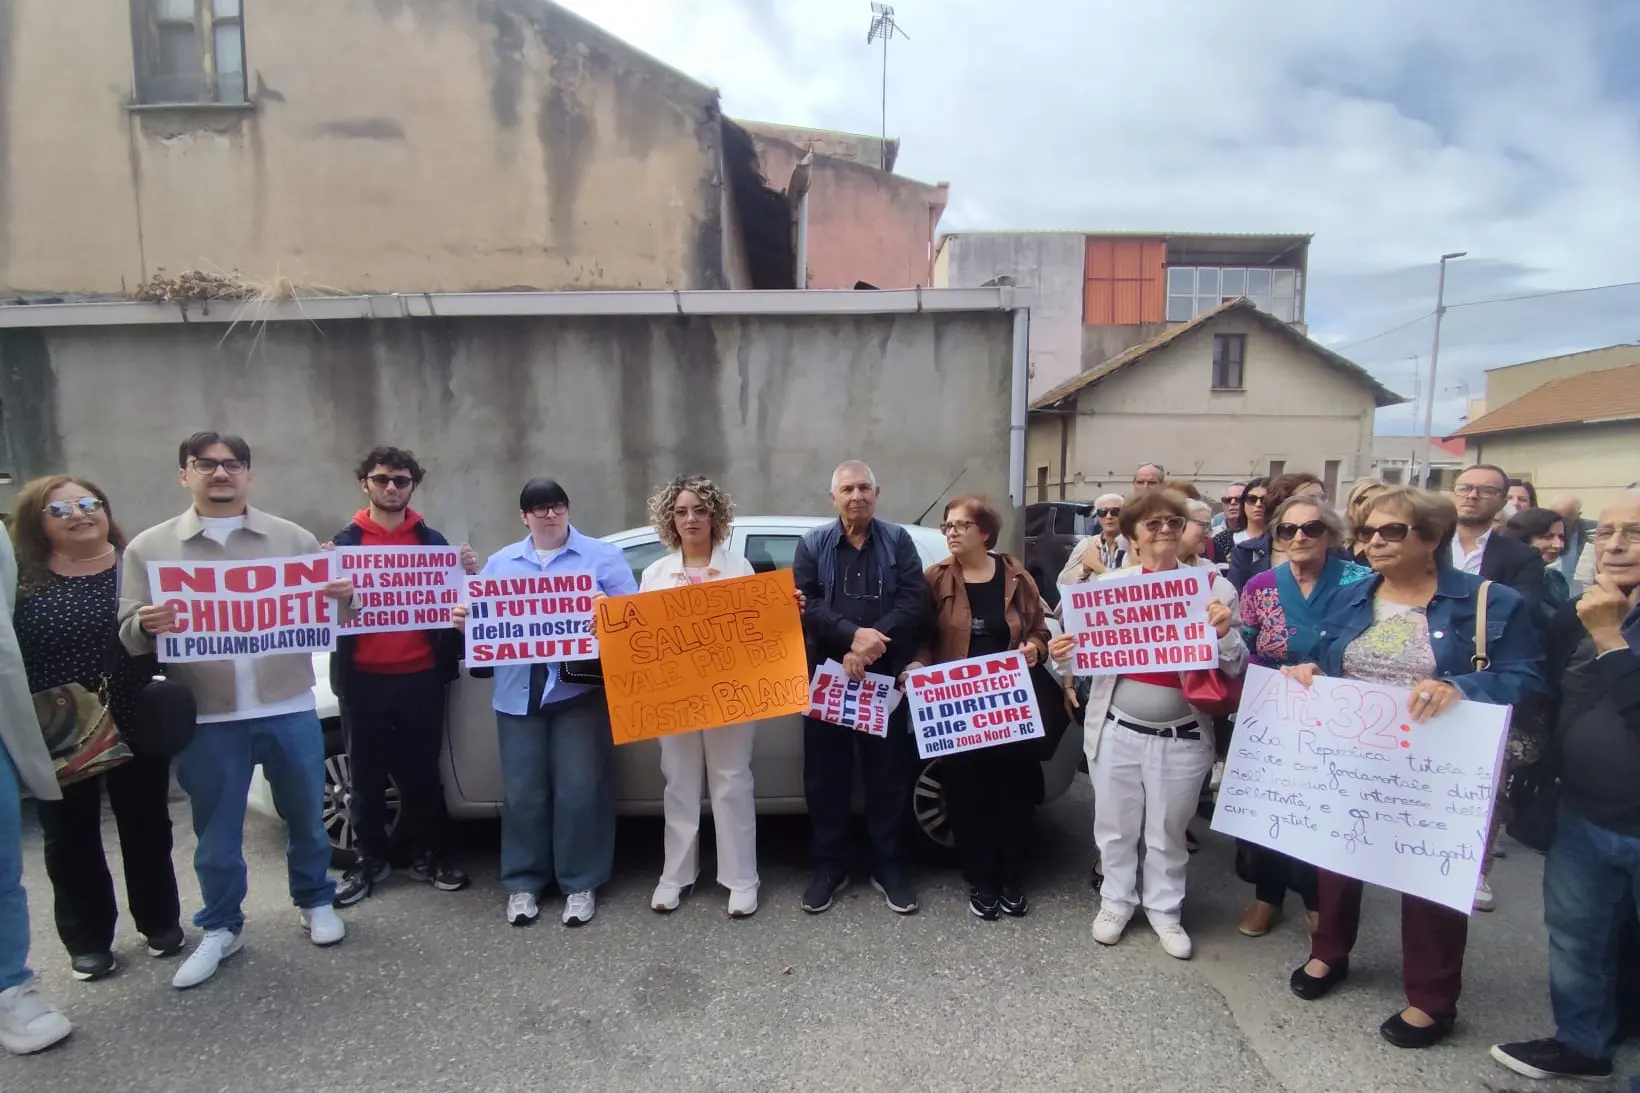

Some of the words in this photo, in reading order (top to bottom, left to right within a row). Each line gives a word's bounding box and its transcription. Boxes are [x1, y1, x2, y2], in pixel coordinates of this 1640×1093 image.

[342, 553, 457, 569] DIFENDIAMO
[159, 558, 329, 593] NON
[352, 573, 375, 588] LA
[379, 571, 449, 588] SANITA'
[468, 574, 592, 598] SALVIAMO
[358, 590, 437, 607] UBBLICA
[441, 588, 458, 604] di
[600, 601, 648, 633] LA
[661, 578, 791, 620] NOSTRA
[1072, 577, 1198, 609] DIFENDIAMO
[163, 590, 331, 633] CHIUDETE
[414, 607, 455, 624] NOR
[472, 602, 488, 619] il
[496, 596, 592, 617] FUTURO
[1085, 610, 1108, 628] LA
[1113, 601, 1190, 625] SANITA'
[165, 637, 181, 657] IL
[184, 627, 331, 656] POLIAMBULATORIO
[472, 622, 524, 640] della
[529, 619, 591, 636] nostra
[630, 610, 763, 664] SALUTE
[1078, 624, 1178, 648] PUBBLICA
[1184, 622, 1205, 640] di
[473, 637, 593, 662] SALUTE
[1077, 648, 1149, 669] REGGIO
[1155, 644, 1212, 665] NORD
[609, 661, 685, 697] VALE
[911, 657, 1019, 688] NON
[876, 683, 889, 698] RC
[916, 673, 1020, 703] "CHIUDETECI"
[918, 707, 933, 721] il
[940, 689, 1028, 718] DIRITTO
[923, 720, 967, 738] alle
[972, 705, 1032, 728] CURE
[926, 738, 954, 753] nella
[956, 734, 982, 747] zona
[984, 726, 1010, 742] Nord
[1020, 722, 1034, 735] RC
